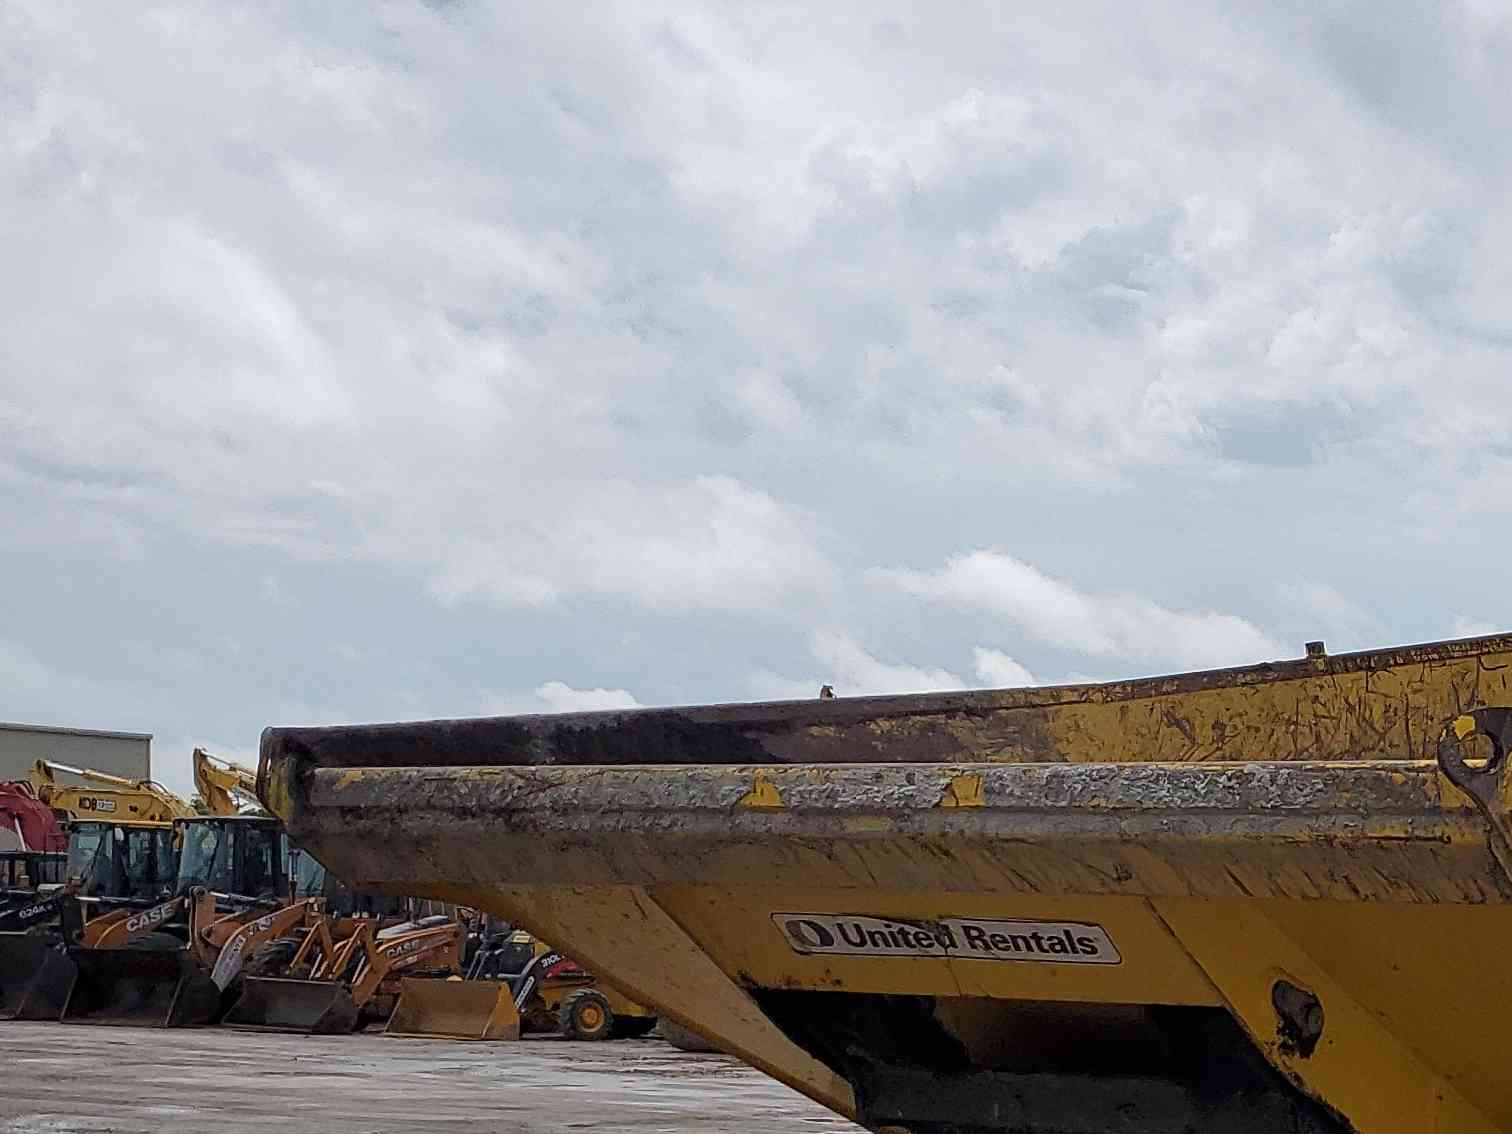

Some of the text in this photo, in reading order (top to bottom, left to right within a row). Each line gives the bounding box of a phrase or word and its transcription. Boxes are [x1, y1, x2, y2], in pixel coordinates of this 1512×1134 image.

[126, 903, 176, 932] CASE
[835, 922, 1098, 956] United Rentals
